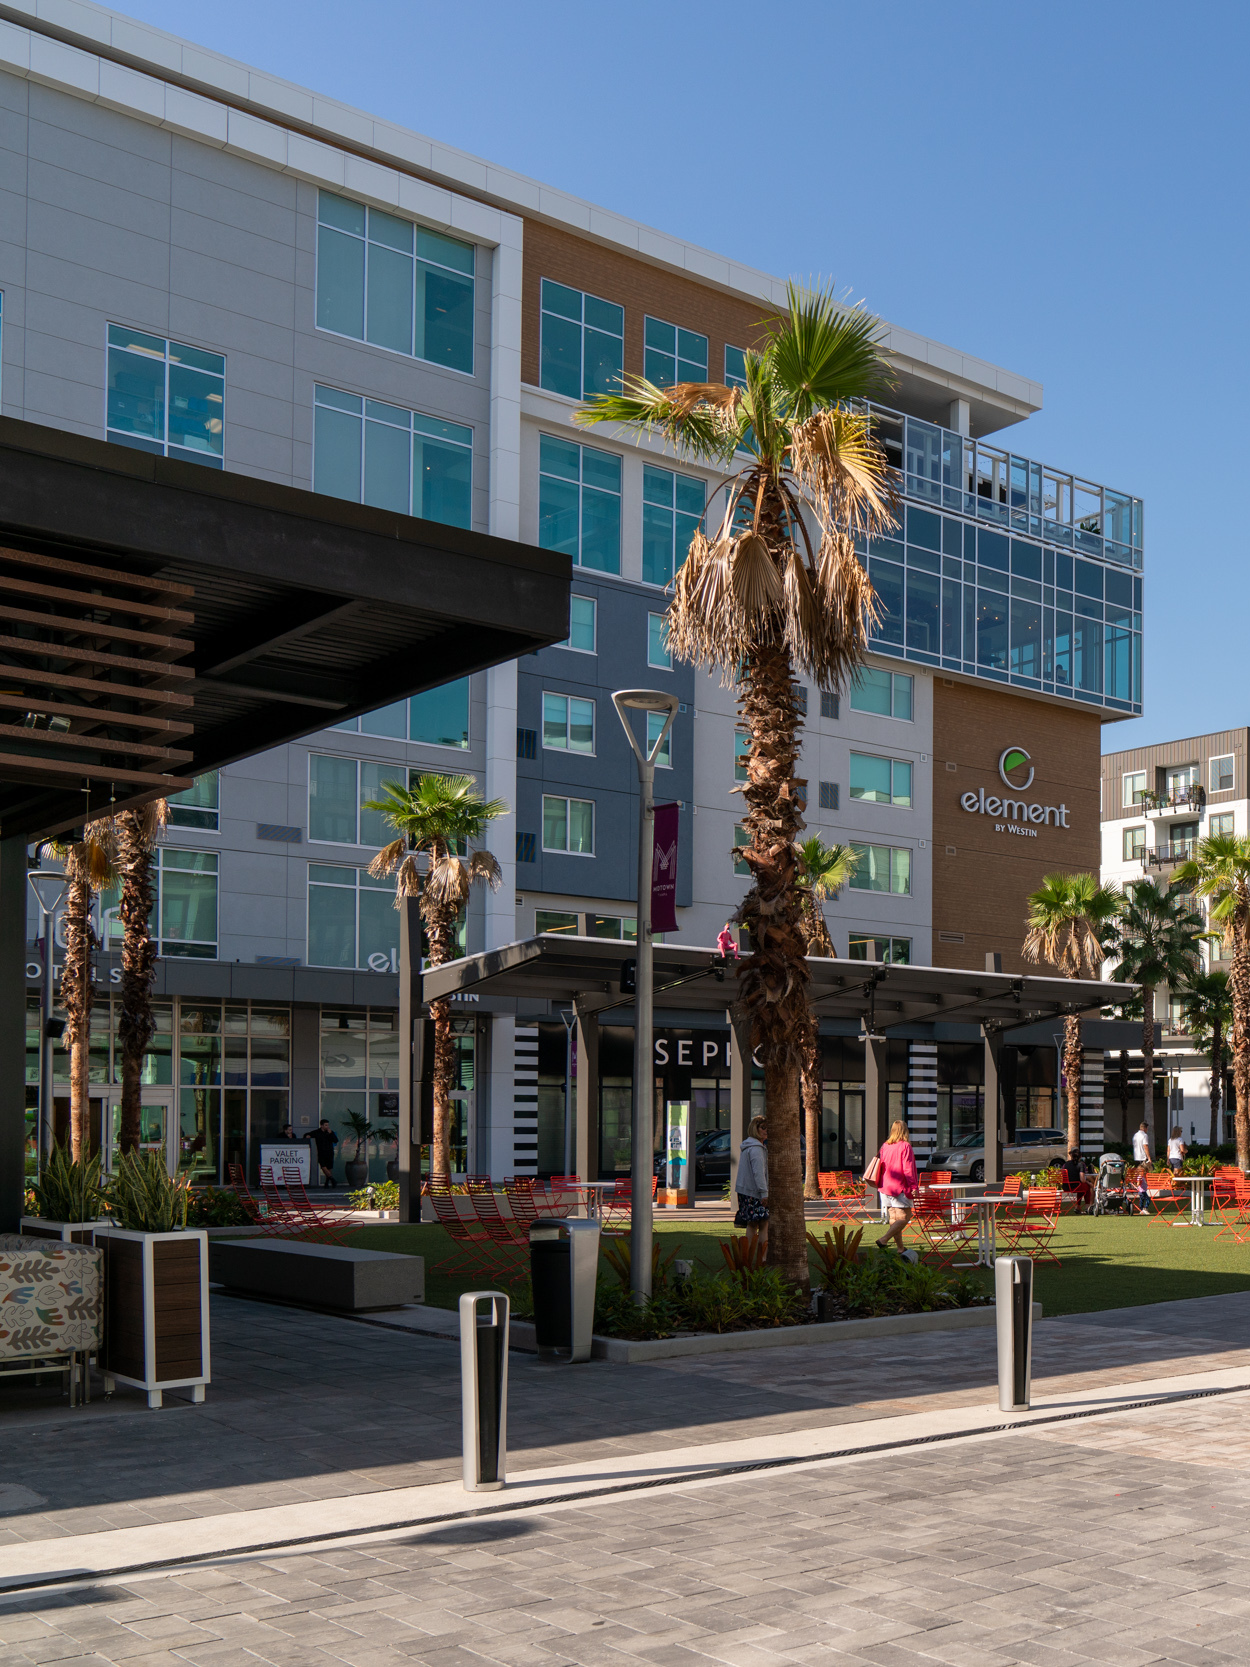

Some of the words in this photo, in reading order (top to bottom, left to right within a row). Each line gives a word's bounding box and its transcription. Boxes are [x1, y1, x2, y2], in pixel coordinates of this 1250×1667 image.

[960, 787, 1071, 828] element
[995, 824, 1006, 832] BY
[1007, 824, 1038, 837] WESTIN
[652, 884, 675, 892] MIDTOWN
[269, 1157, 304, 1165] PARKING
